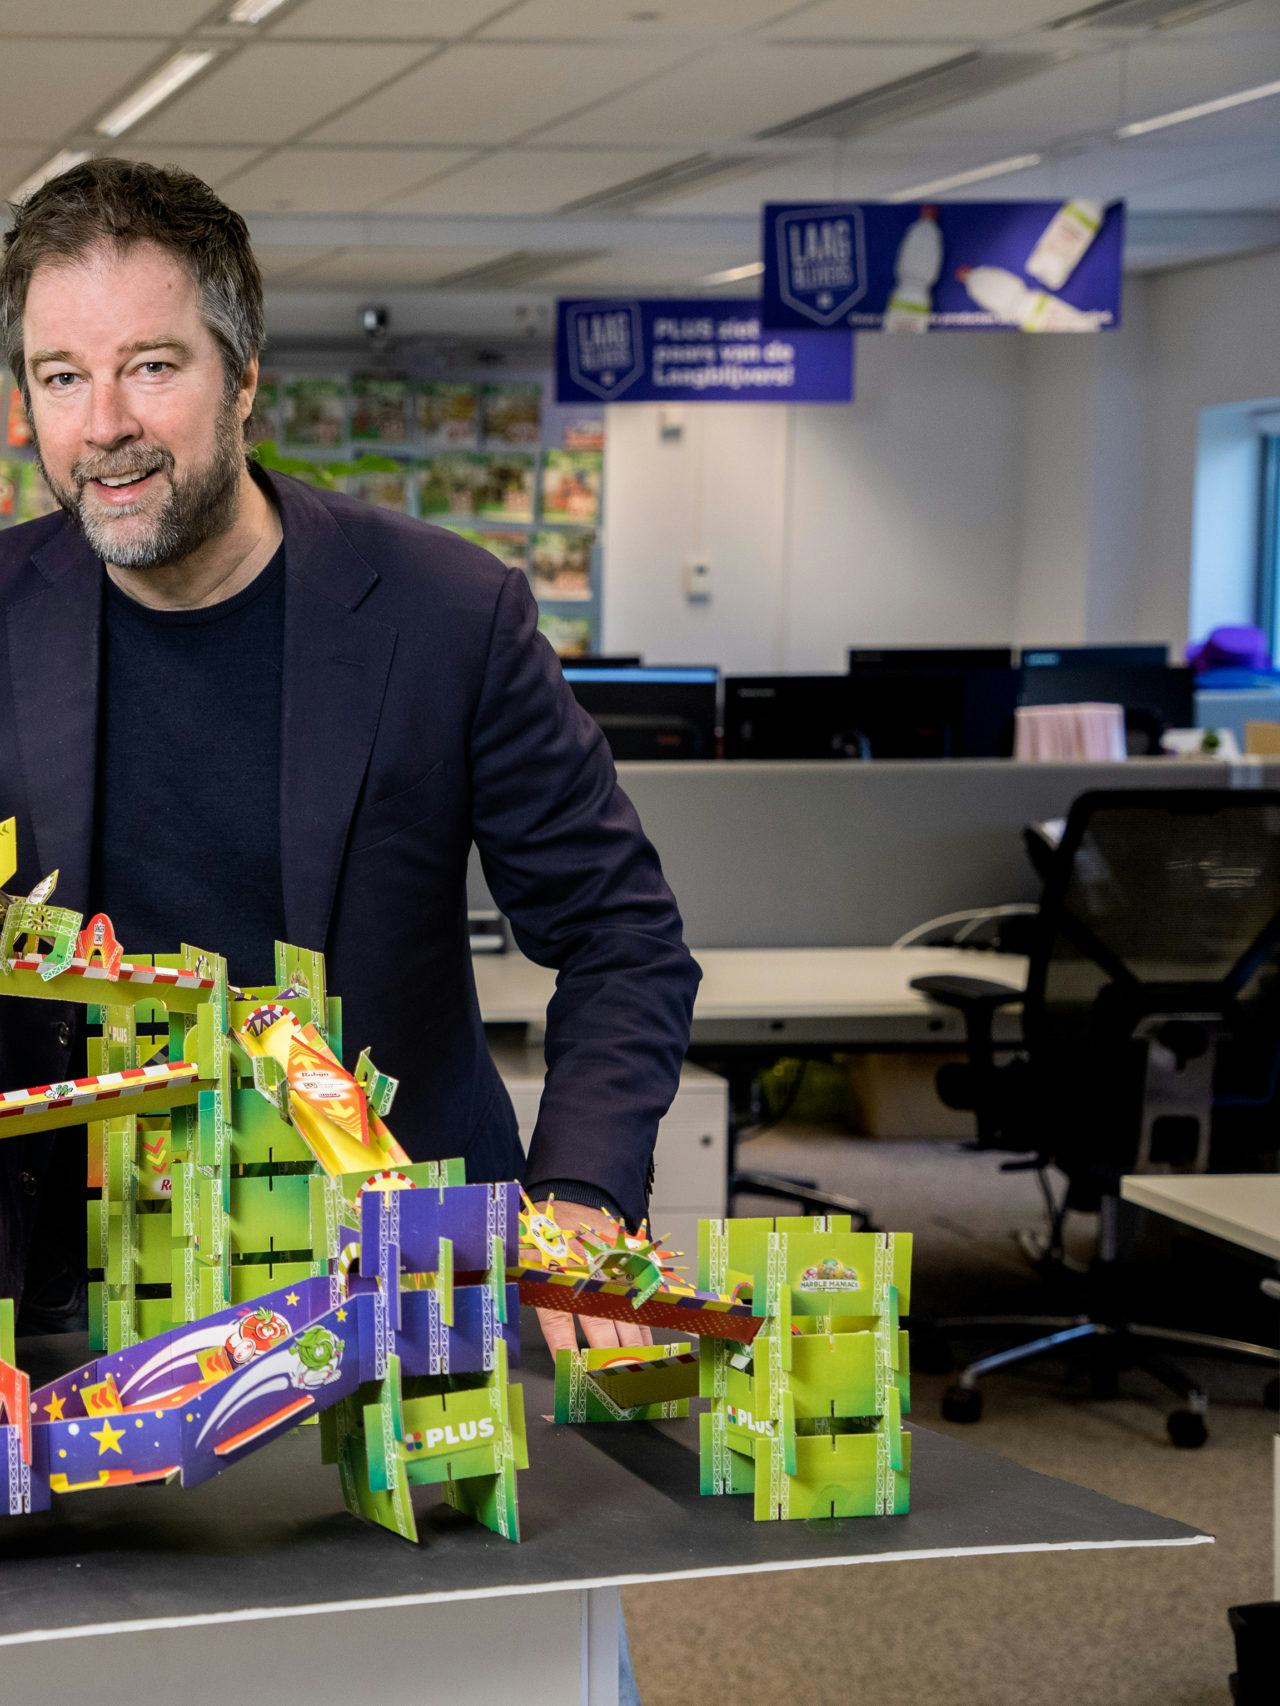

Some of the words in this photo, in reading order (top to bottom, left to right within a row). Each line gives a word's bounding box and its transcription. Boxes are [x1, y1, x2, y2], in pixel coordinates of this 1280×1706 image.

[653, 318, 713, 340] PLUS
[720, 344, 762, 364] van
[764, 340, 795, 363] de
[425, 1417, 495, 1449] PLUS
[737, 1408, 775, 1437] PLUS
